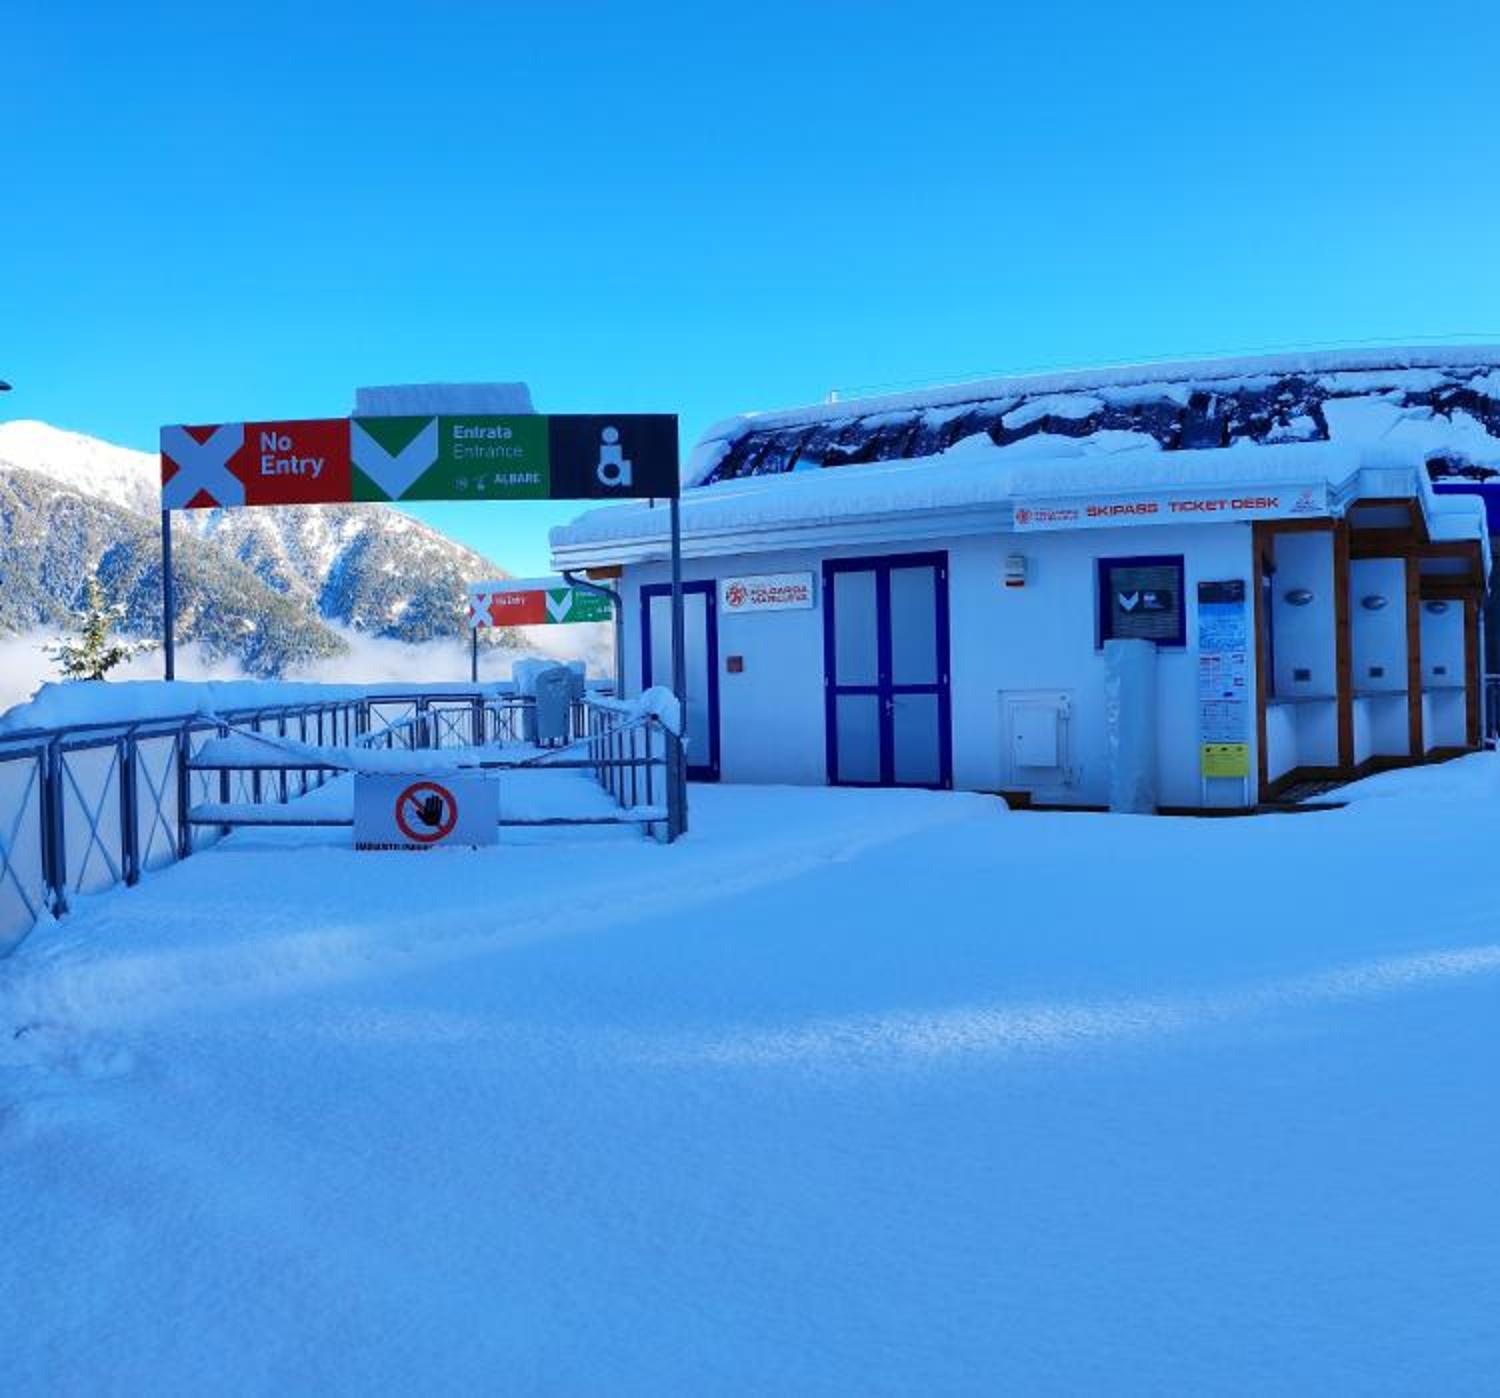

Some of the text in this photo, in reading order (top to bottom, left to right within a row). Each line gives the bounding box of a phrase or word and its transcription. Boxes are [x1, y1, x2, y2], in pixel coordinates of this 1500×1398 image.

[260, 431, 291, 452] No
[453, 425, 512, 439] Entrata
[454, 443, 523, 459] Entrance
[261, 454, 325, 479] Entry
[1087, 503, 1159, 517] SKIPASS
[1168, 500, 1225, 512] TICKET
[1231, 497, 1280, 510] DESK
